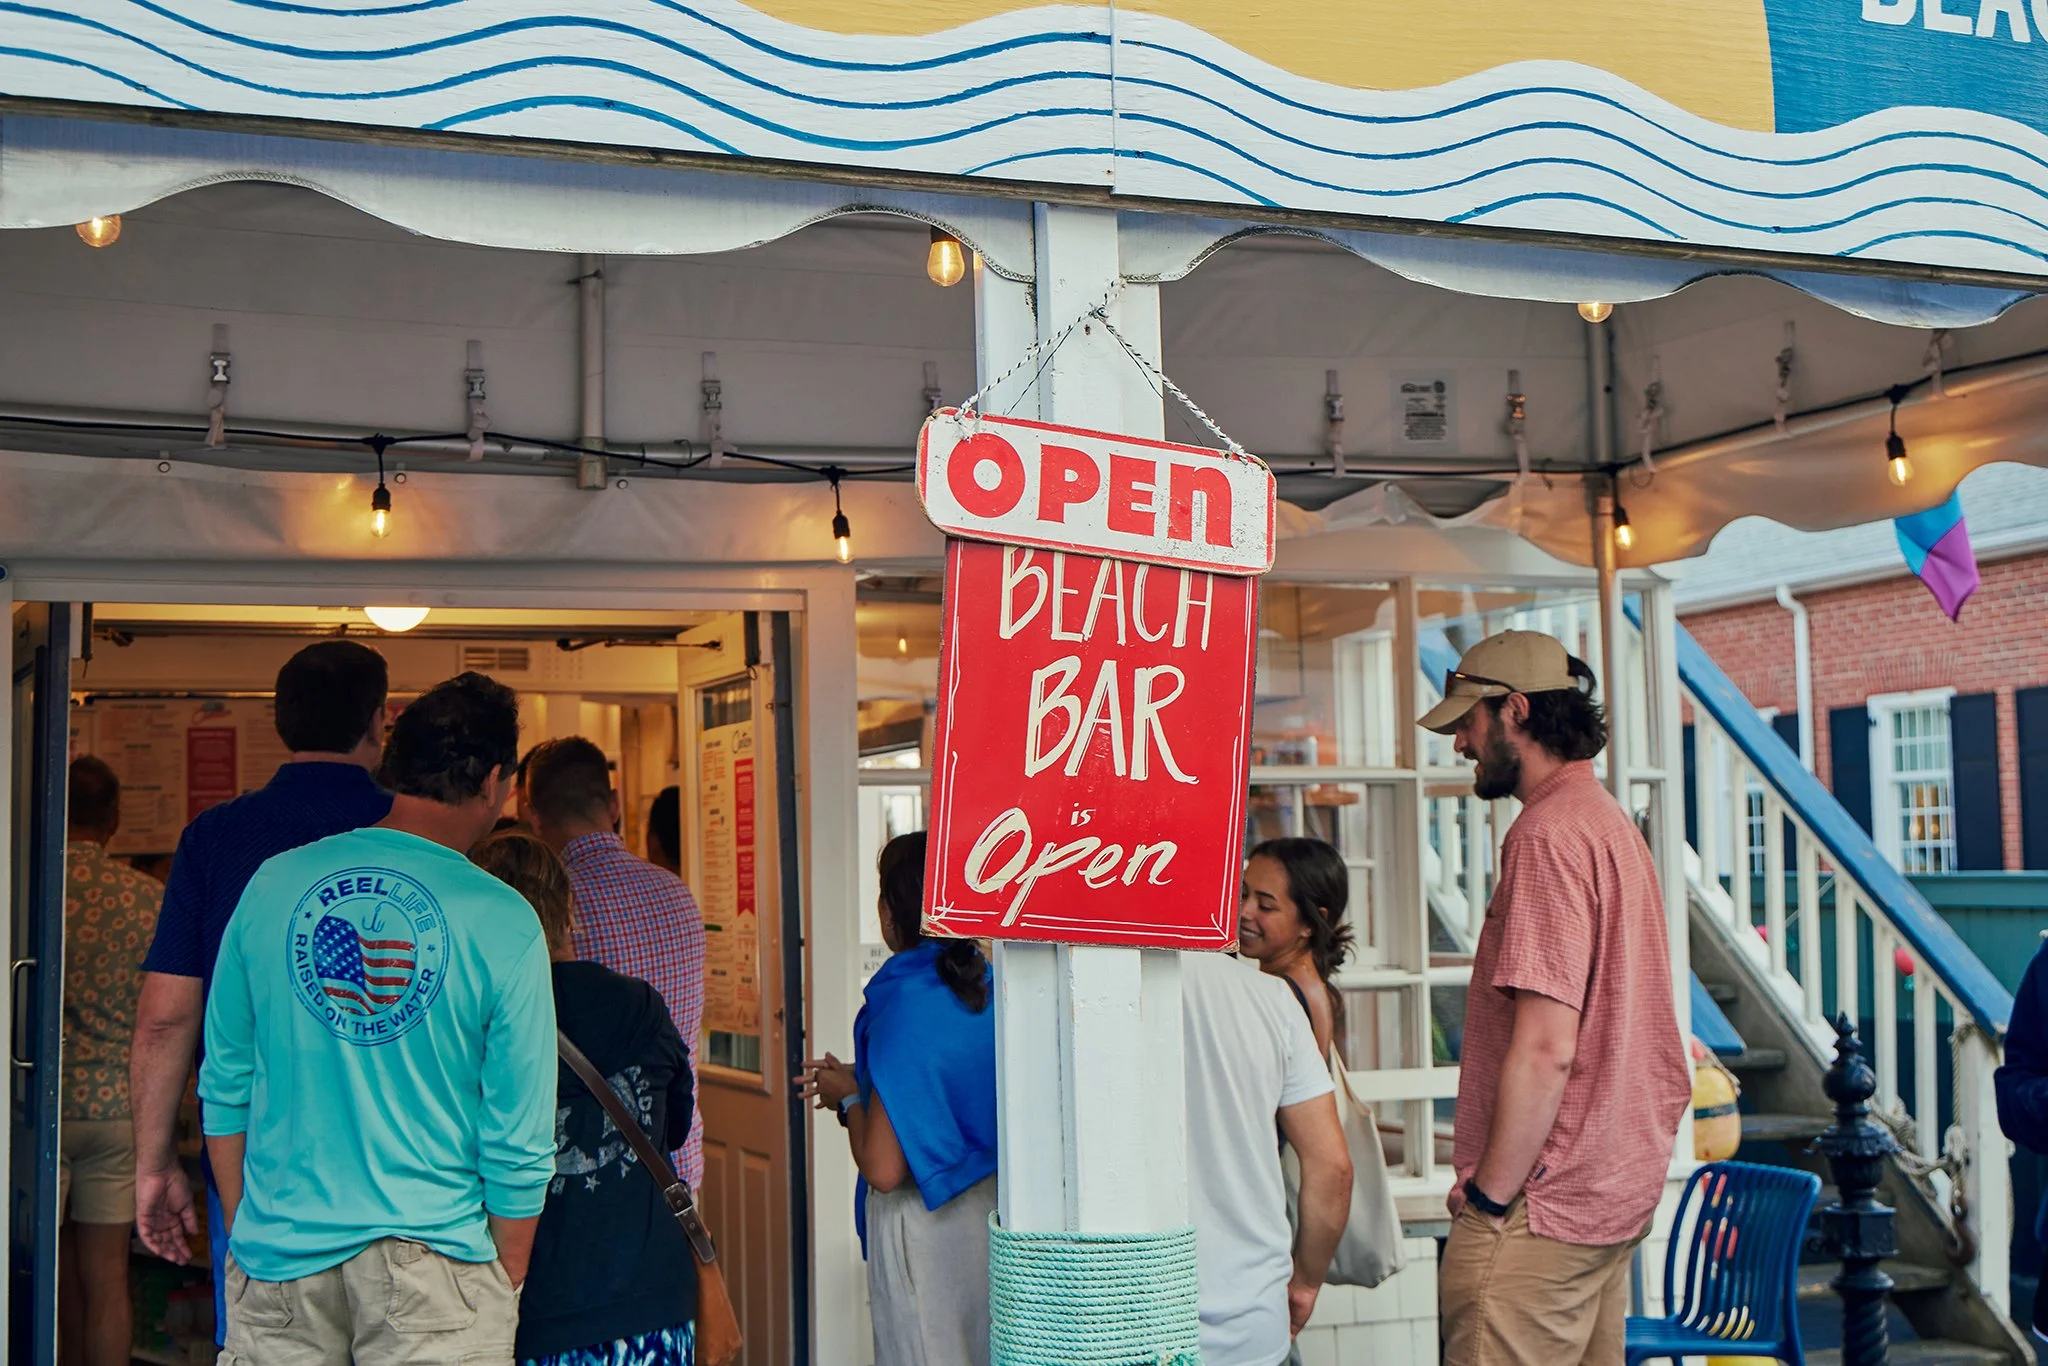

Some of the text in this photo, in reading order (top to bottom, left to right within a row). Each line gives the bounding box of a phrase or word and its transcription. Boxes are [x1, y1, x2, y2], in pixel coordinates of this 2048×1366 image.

[999, 545, 1214, 651] BEACH
[1025, 656, 1199, 784] BAR
[963, 807, 1177, 927] Open
[1070, 803, 1096, 826] is
[295, 934, 437, 1037] RAISED ON THE WATER
